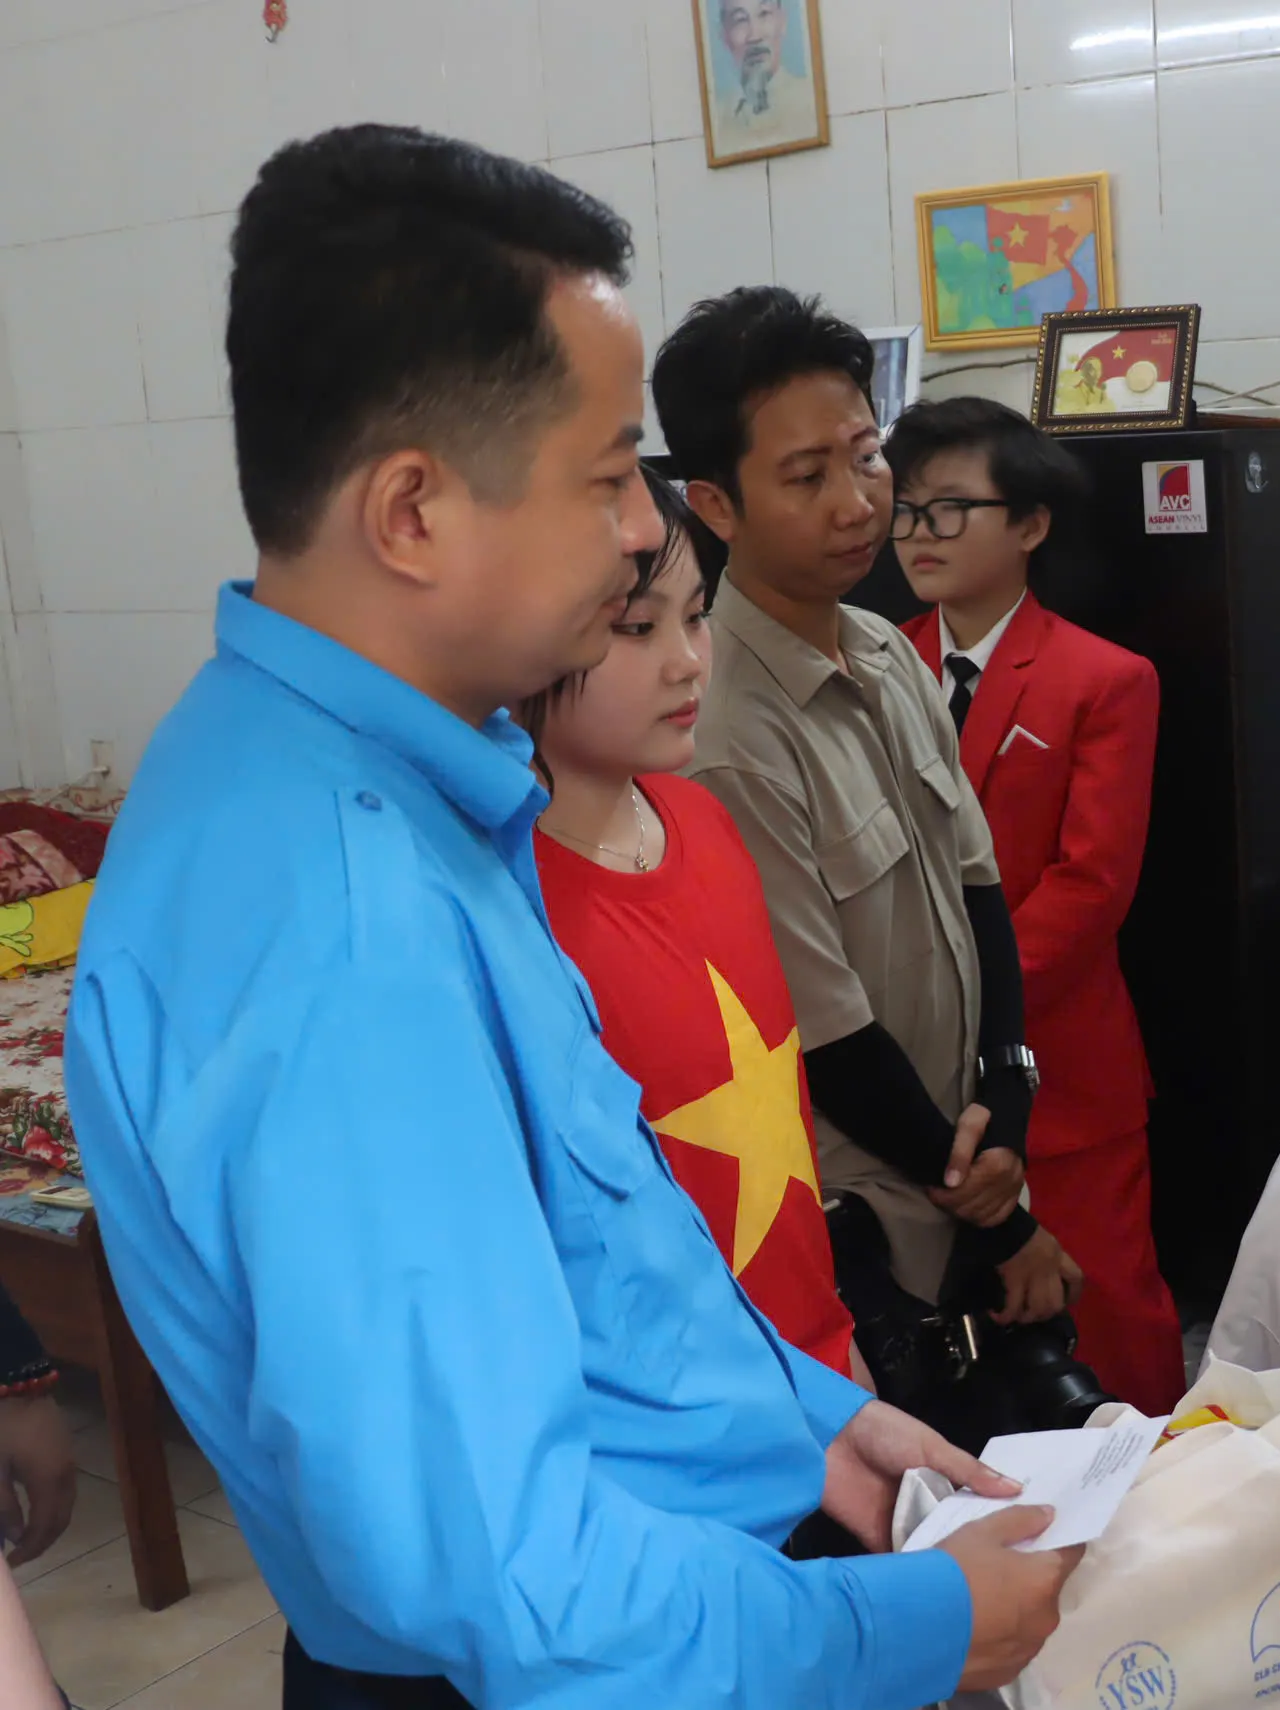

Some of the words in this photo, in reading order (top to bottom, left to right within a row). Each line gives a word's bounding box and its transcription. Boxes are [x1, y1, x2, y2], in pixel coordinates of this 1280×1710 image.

[1160, 495, 1191, 510] AVC
[1148, 515, 1175, 524] ASEAN
[1107, 1666, 1165, 1710] YSW
